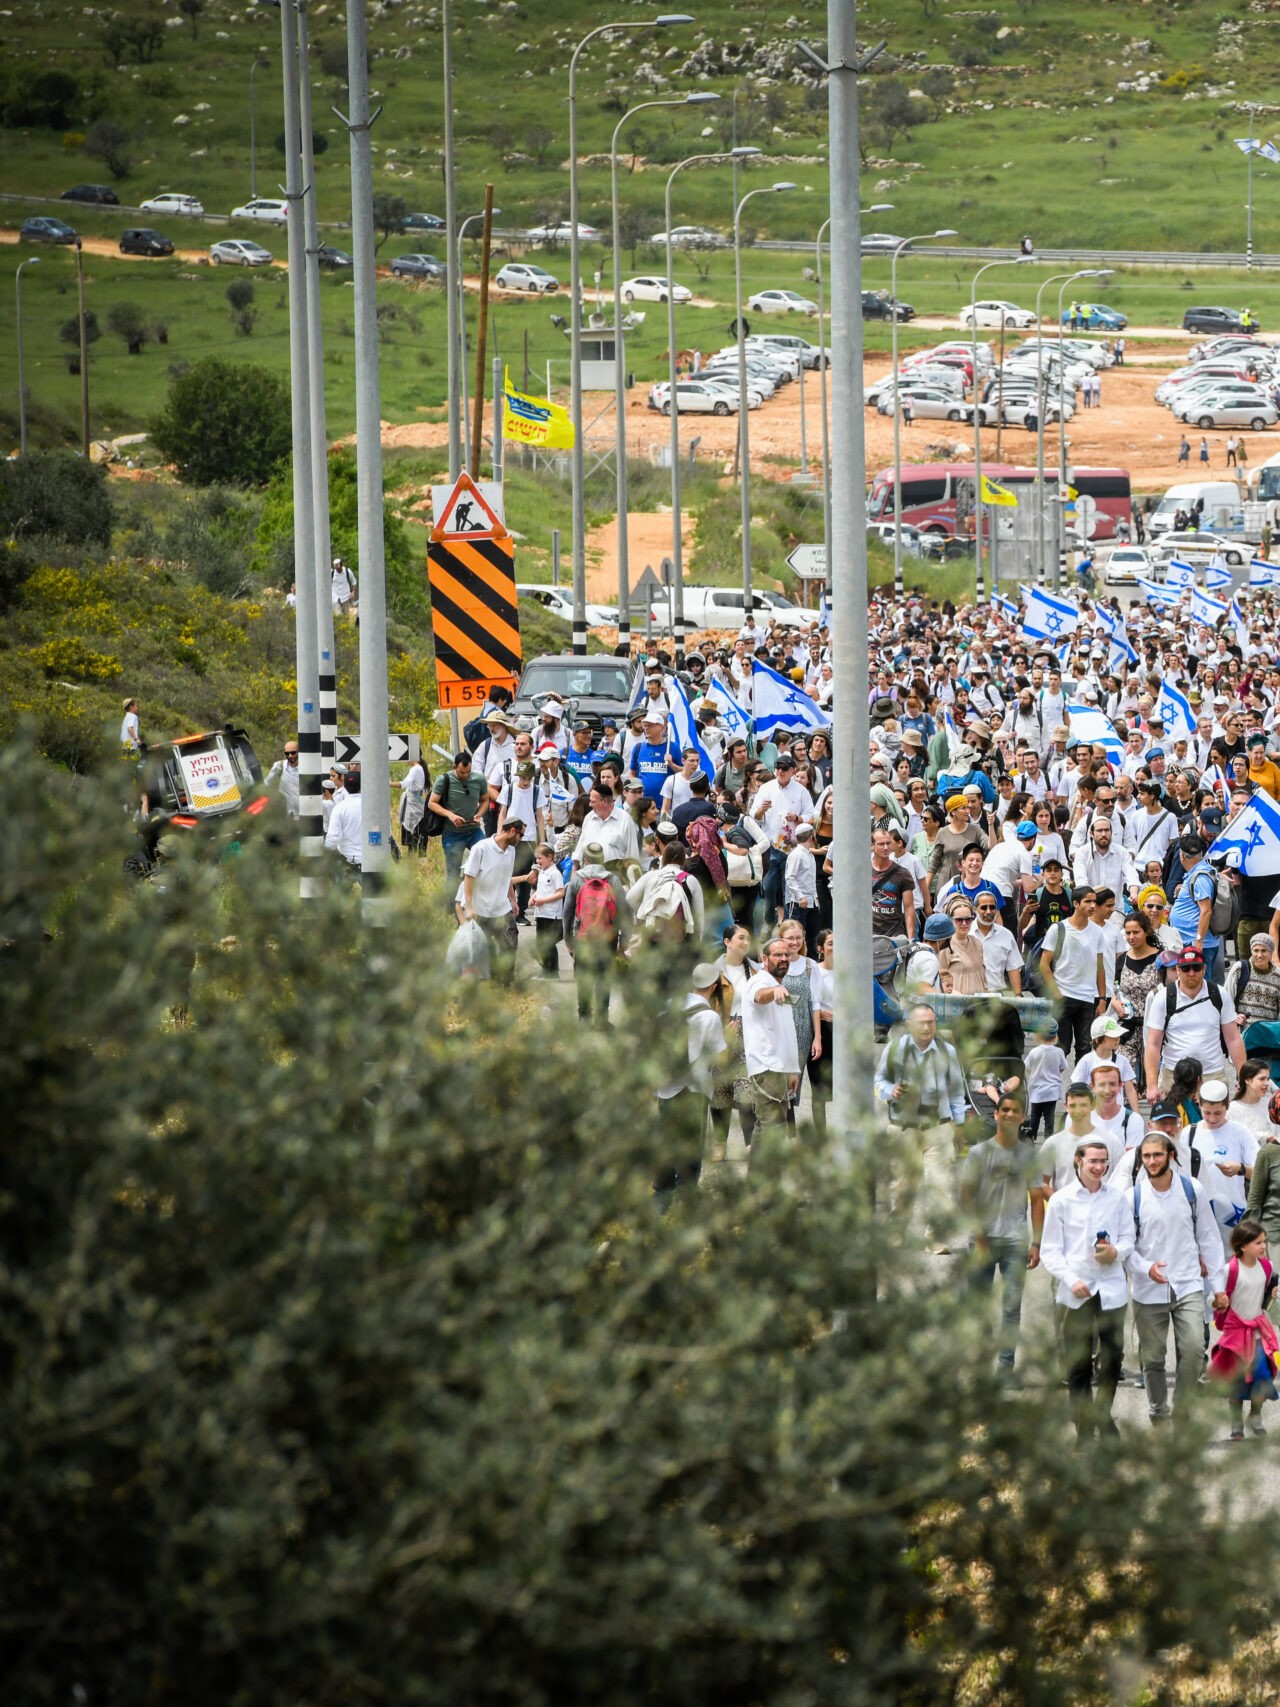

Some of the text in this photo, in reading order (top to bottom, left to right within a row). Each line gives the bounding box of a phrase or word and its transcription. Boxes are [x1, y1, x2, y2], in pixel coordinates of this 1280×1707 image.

[462, 685, 497, 701] 55
[190, 755, 219, 769] חילוץ
[191, 764, 224, 778] והצלה
